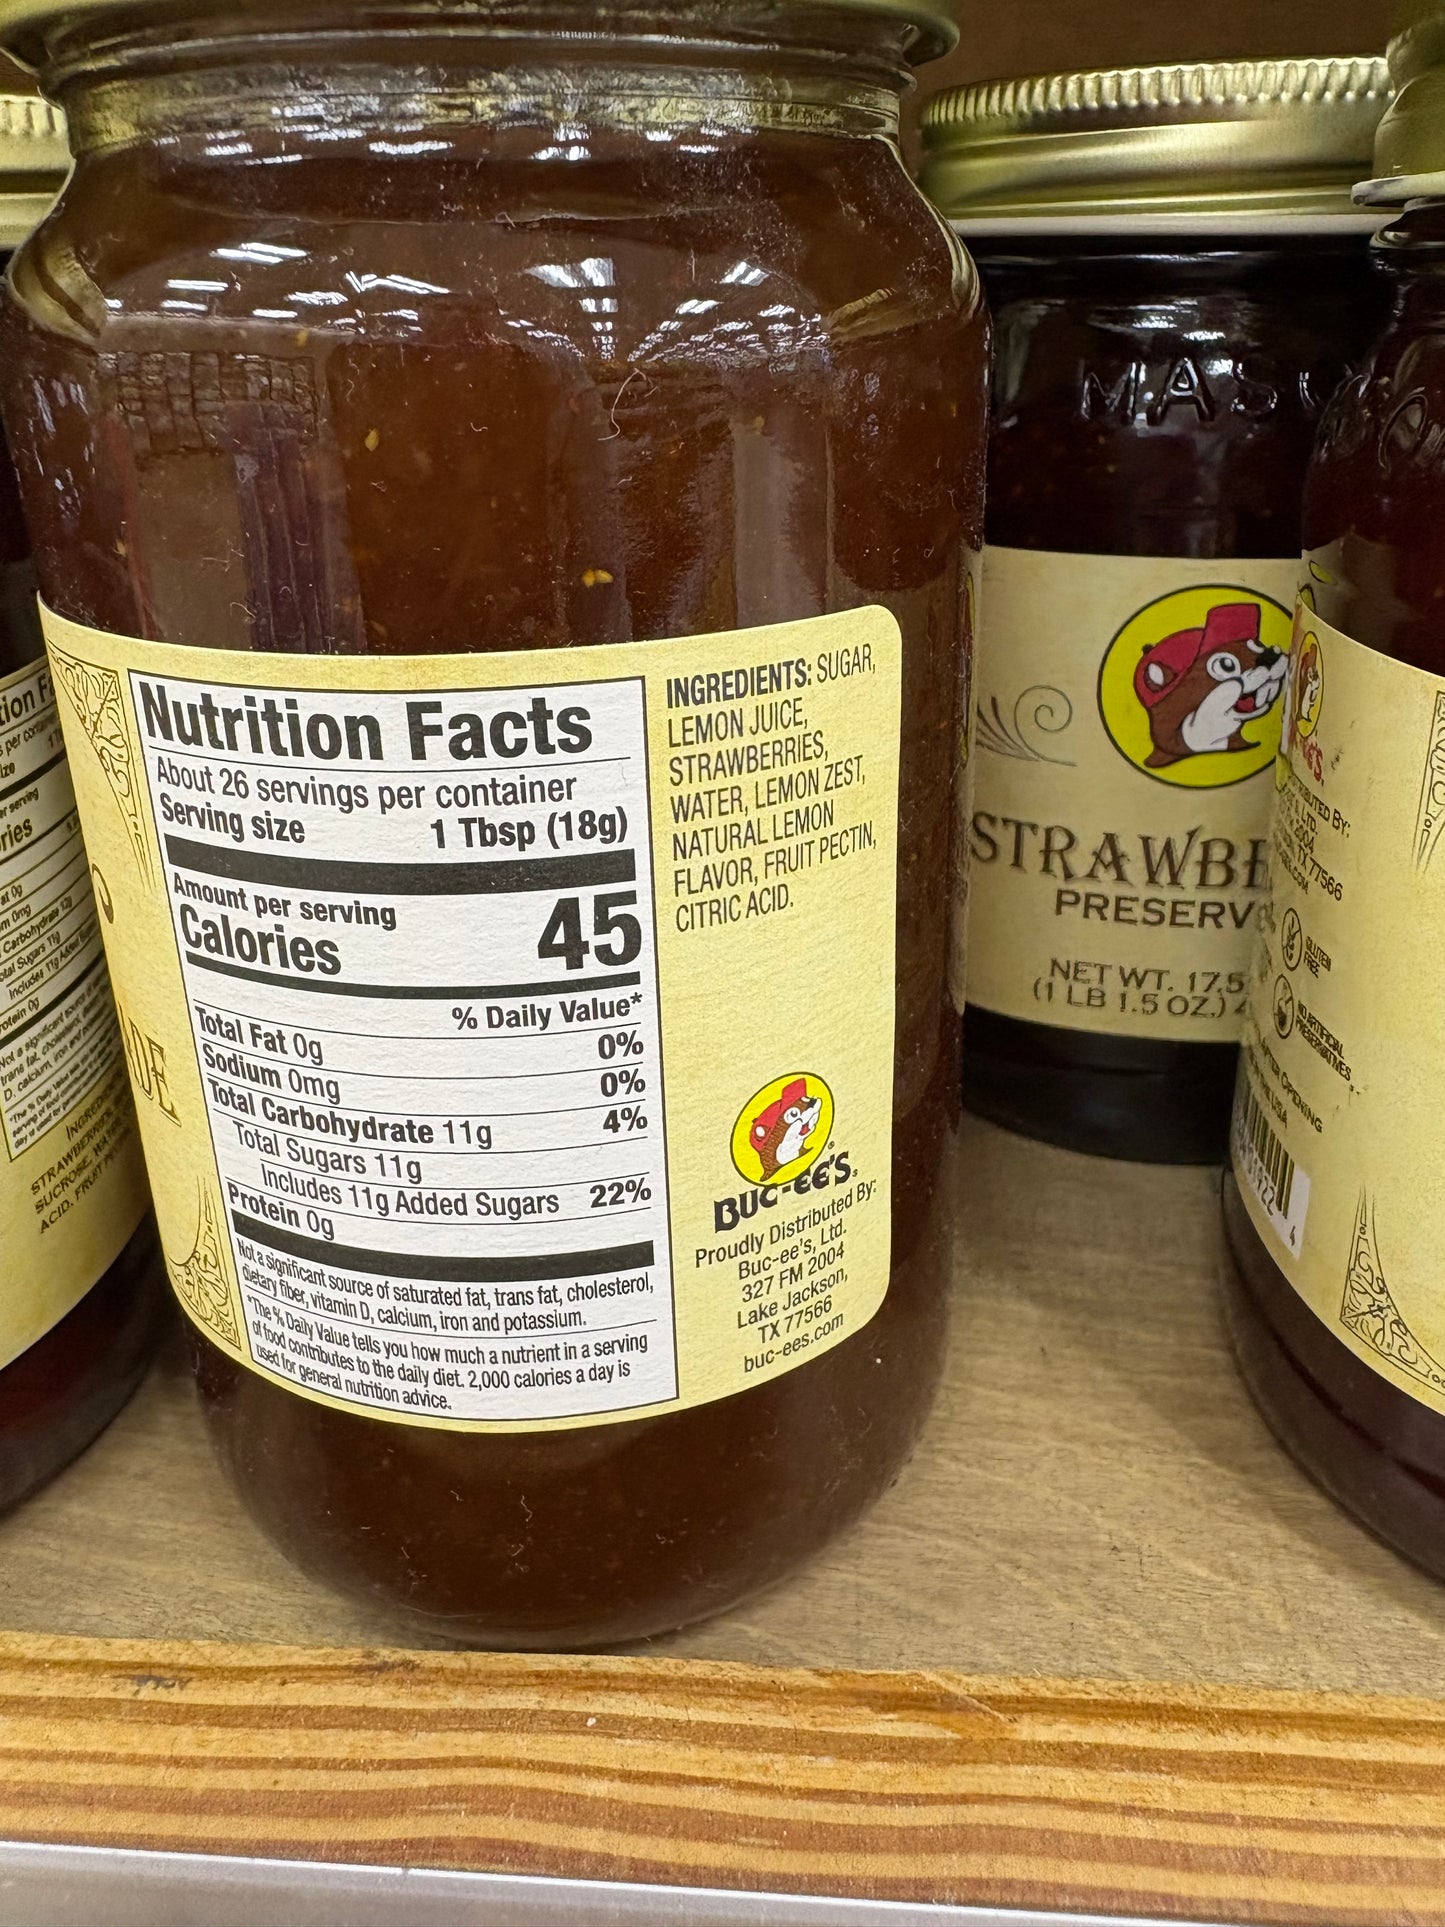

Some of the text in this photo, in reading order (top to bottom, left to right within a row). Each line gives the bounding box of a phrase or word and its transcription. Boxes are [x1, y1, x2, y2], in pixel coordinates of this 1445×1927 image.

[666, 643, 877, 709] INGREDIENTS: SUGAR,
[139, 681, 384, 760] Nutrition
[405, 696, 593, 761] Facts
[668, 697, 808, 748] LEMON JUICE,
[157, 755, 578, 815] About 26 servings per container
[669, 730, 829, 786] STRAWBERRIES,
[670, 755, 866, 824] WATER, LEMON ZEST,
[161, 793, 628, 851] Serving size 1 Tbsp (18g)
[672, 799, 834, 861] NATURAL LEMON
[674, 820, 877, 897] FLAVOR, FRUIT PECTIN,
[1309, 856, 1343, 901] 77566
[173, 872, 397, 931] Amount per serving
[675, 883, 794, 933] CITRIC ACID.
[179, 903, 342, 976] Calories
[537, 890, 643, 971] 45
[1050, 958, 1112, 985] NET
[1119, 965, 1173, 992] WT.
[1067, 984, 1106, 1008] LB
[195, 1005, 645, 1066] Total Fat 0g 0%
[452, 1006, 478, 1030] %
[486, 1004, 552, 1031] Daily
[202, 1043, 646, 1105] Sodium 0mg 0%
[207, 1078, 648, 1149] Total Carbohydrate 11g 4%
[233, 1120, 422, 1186] Total Sugars 11g
[227, 1182, 335, 1241] Protein 0g
[261, 1163, 652, 1220] Includes 11g Added Sugars 22%
[695, 1179, 878, 1268] Proudly Distributed By:
[739, 1222, 847, 1280] Buc-ee's, Ltd.
[236, 1238, 654, 1310] Not a significant source of saturated fat, trans fat, cholesterol,
[242, 1264, 587, 1335] dietary fiber, vitamin D, calcium, iron and potassium.
[737, 1267, 848, 1329] Lake Jackson,
[742, 1241, 845, 1303] 327 FM 2004
[272, 1305, 285, 1327] %
[285, 1311, 313, 1341] Daily
[315, 1322, 349, 1348] Value
[352, 1332, 380, 1354] tells
[383, 1340, 407, 1359] you
[411, 1341, 440, 1362] how
[444, 1346, 486, 1364] much
[489, 1350, 498, 1364] a
[502, 1343, 560, 1364] nutrient
[563, 1341, 577, 1360] in
[581, 1344, 591, 1359] a
[594, 1333, 648, 1355] serving
[744, 1311, 844, 1374] buc-ees.com
[758, 1295, 833, 1344] TX 77566
[252, 1320, 631, 1391] of food contributes to the daily diet. 2,000 calories a day is
[256, 1343, 452, 1410] used for general nutrition advice.
